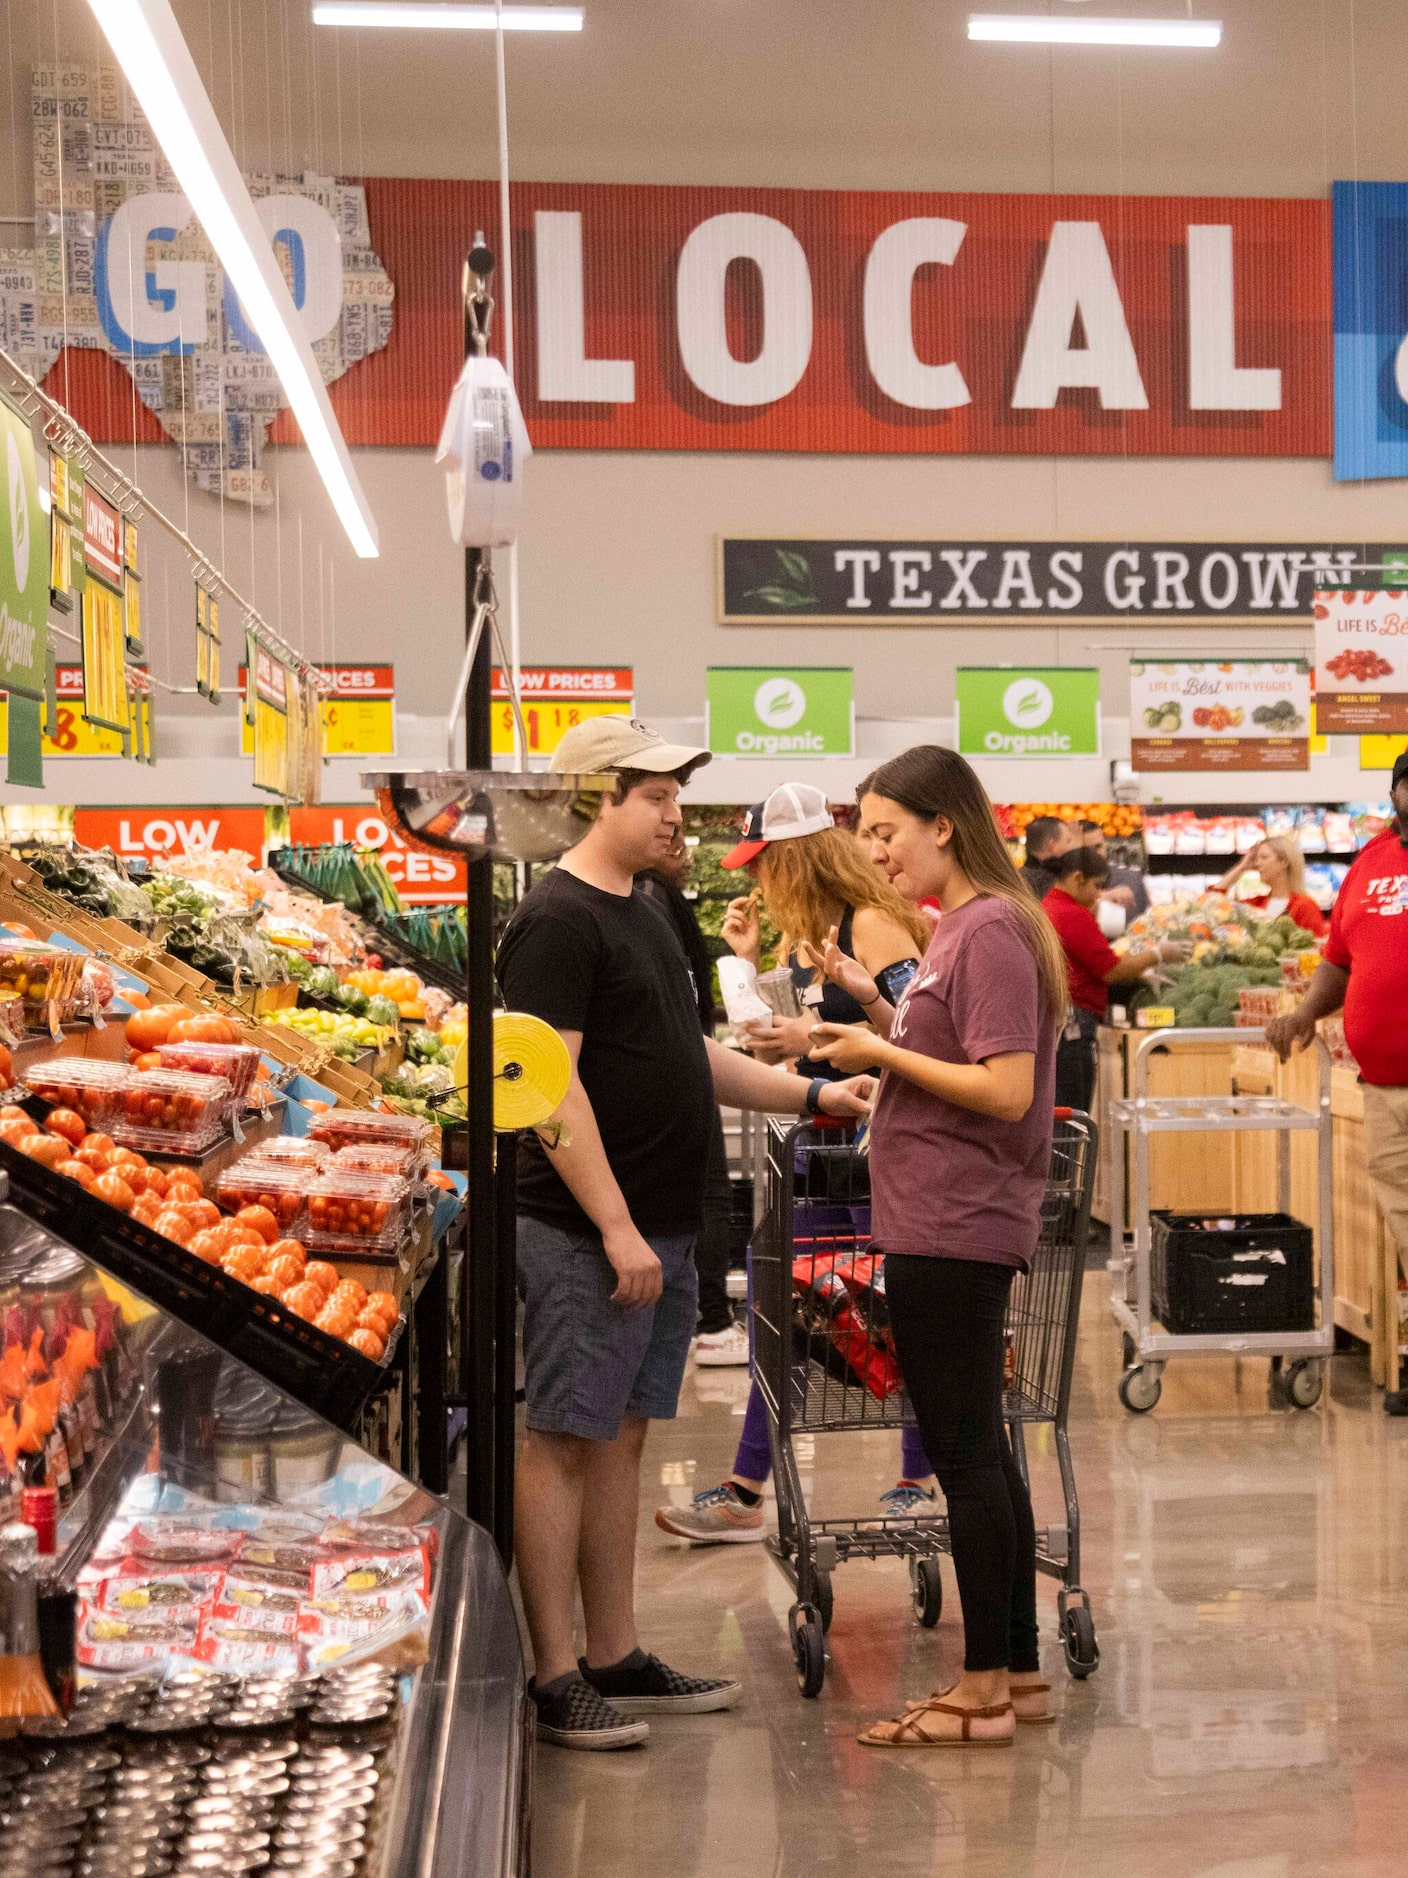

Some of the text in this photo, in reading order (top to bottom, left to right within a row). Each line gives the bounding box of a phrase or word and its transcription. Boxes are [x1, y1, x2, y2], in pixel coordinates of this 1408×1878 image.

[105, 192, 343, 345] GO
[534, 209, 1282, 411] LOCAL
[834, 549, 1084, 610] TEXAS
[1104, 549, 1357, 609] GROWN
[1338, 619, 1363, 633] LIFE
[1366, 619, 1378, 633] IS
[548, 673, 617, 689] PRICES
[1149, 677, 1293, 696] LIFE IS Best WITH VEGGIES
[736, 731, 825, 754] Organic
[985, 731, 1072, 754] Organic
[119, 819, 221, 851] LOW
